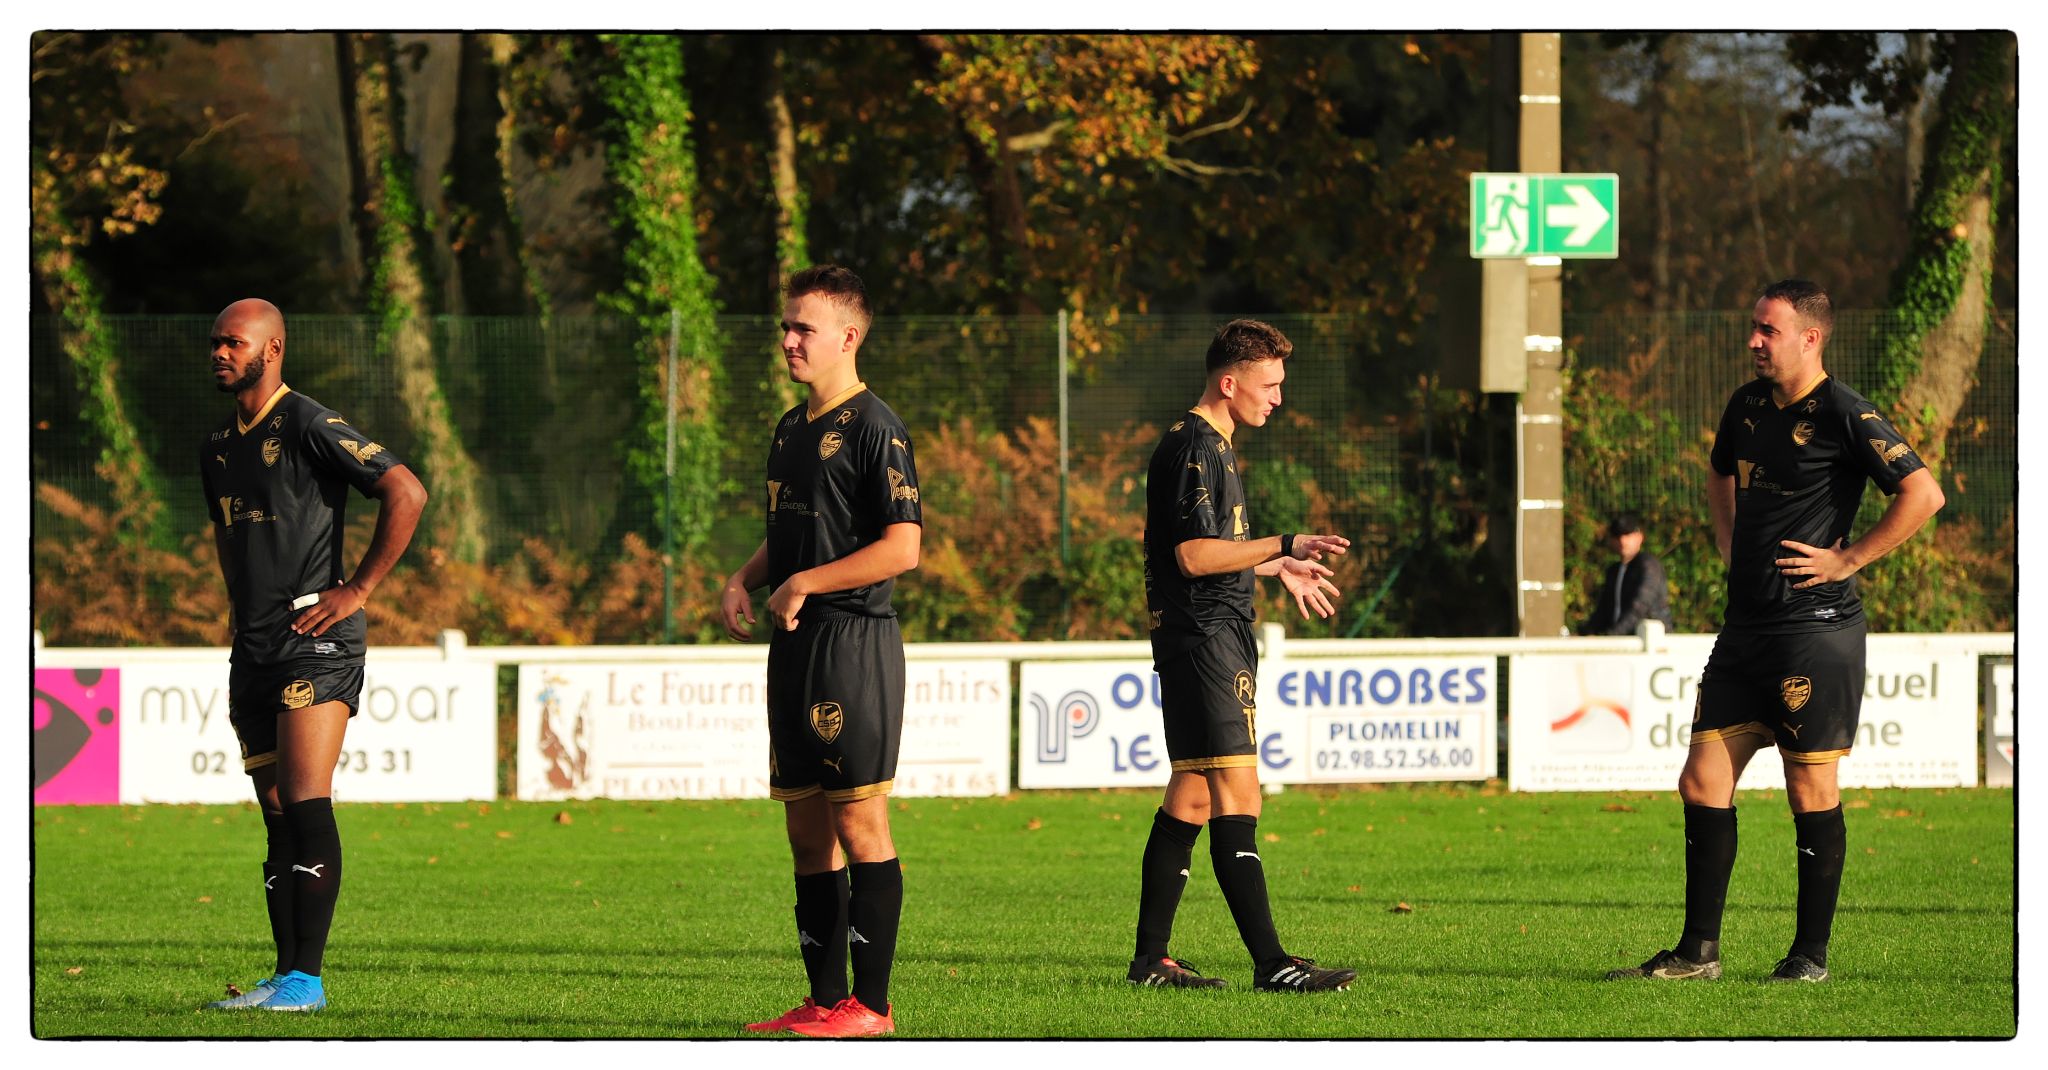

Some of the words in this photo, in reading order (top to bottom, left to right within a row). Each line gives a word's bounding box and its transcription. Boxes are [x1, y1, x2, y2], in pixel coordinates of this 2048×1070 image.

[1330, 721, 1461, 741] PLOMELIN
[192, 750, 227, 775] 02
[381, 748, 412, 774] 31
[1316, 748, 1473, 770] 02.98.52.56.00
